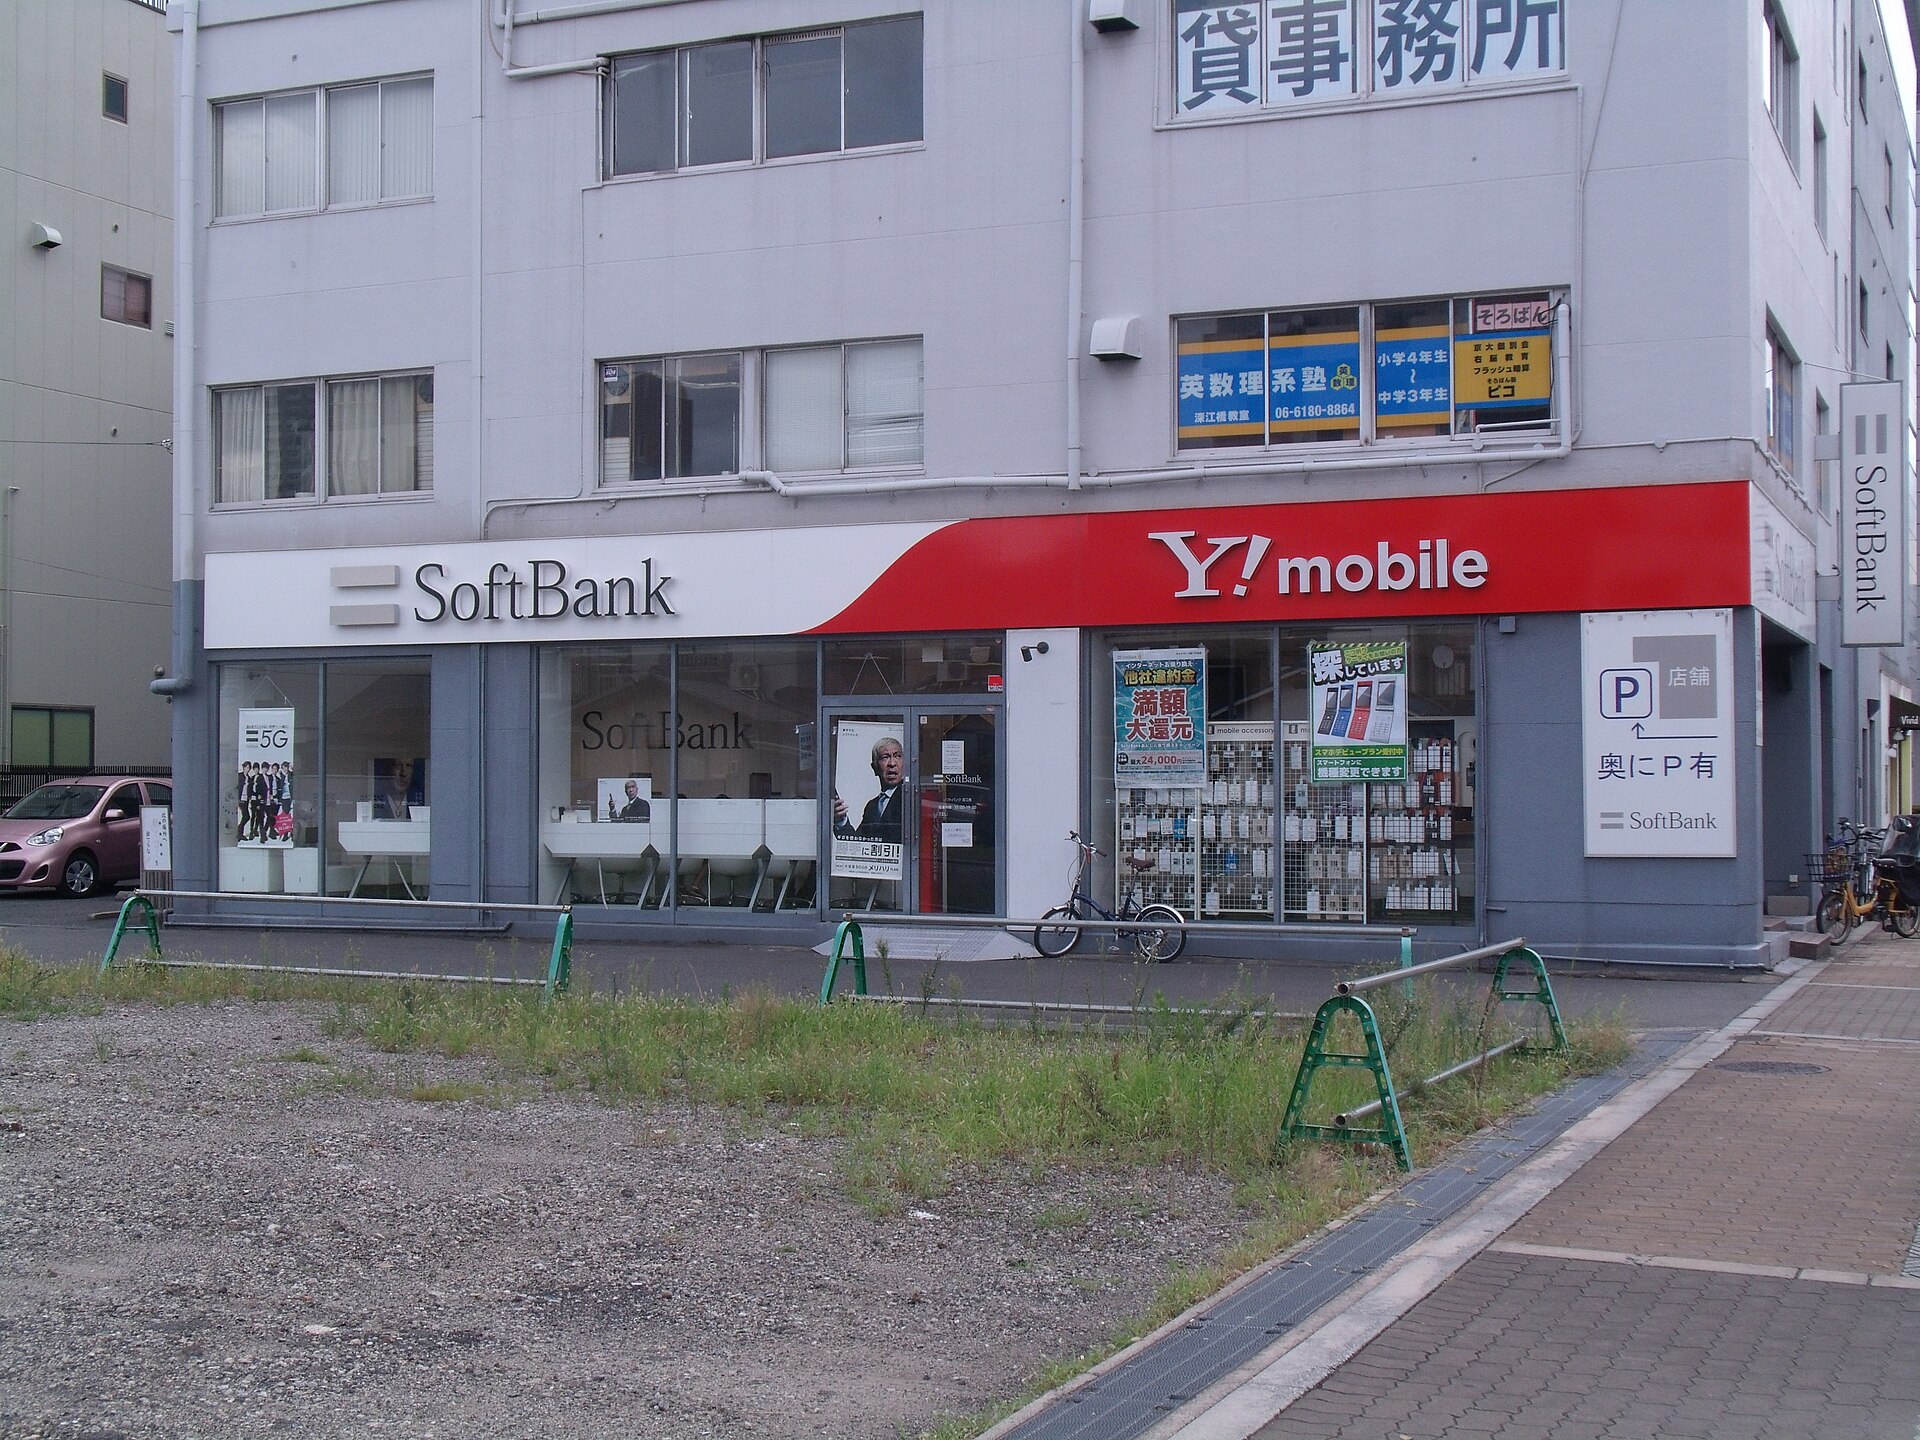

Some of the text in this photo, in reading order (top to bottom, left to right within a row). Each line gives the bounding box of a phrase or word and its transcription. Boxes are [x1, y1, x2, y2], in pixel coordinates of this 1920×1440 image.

[1180, 0, 1558, 110] 貸事務所
[1478, 306, 1548, 326] そろばん
[1377, 349, 1449, 367] 小学4年生
[1179, 365, 1327, 400] 英数理系塾
[1488, 385, 1516, 399] ピコ
[1377, 386, 1449, 404] 中学3年生
[1274, 403, 1356, 420] 06-6180-8864
[1854, 465, 1888, 614] SoftBank
[413, 557, 676, 623] SoftBank
[1124, 668, 1196, 685] 他社違約金
[1667, 666, 1711, 687] 店舗
[1132, 688, 1187, 716] 満額
[1615, 676, 1640, 713] P
[582, 711, 753, 750] SoftBank
[1125, 717, 1193, 741] 大還元
[260, 730, 289, 749] 5G
[945, 774, 982, 784] SoftBank
[1630, 811, 1718, 830] SoftBank
